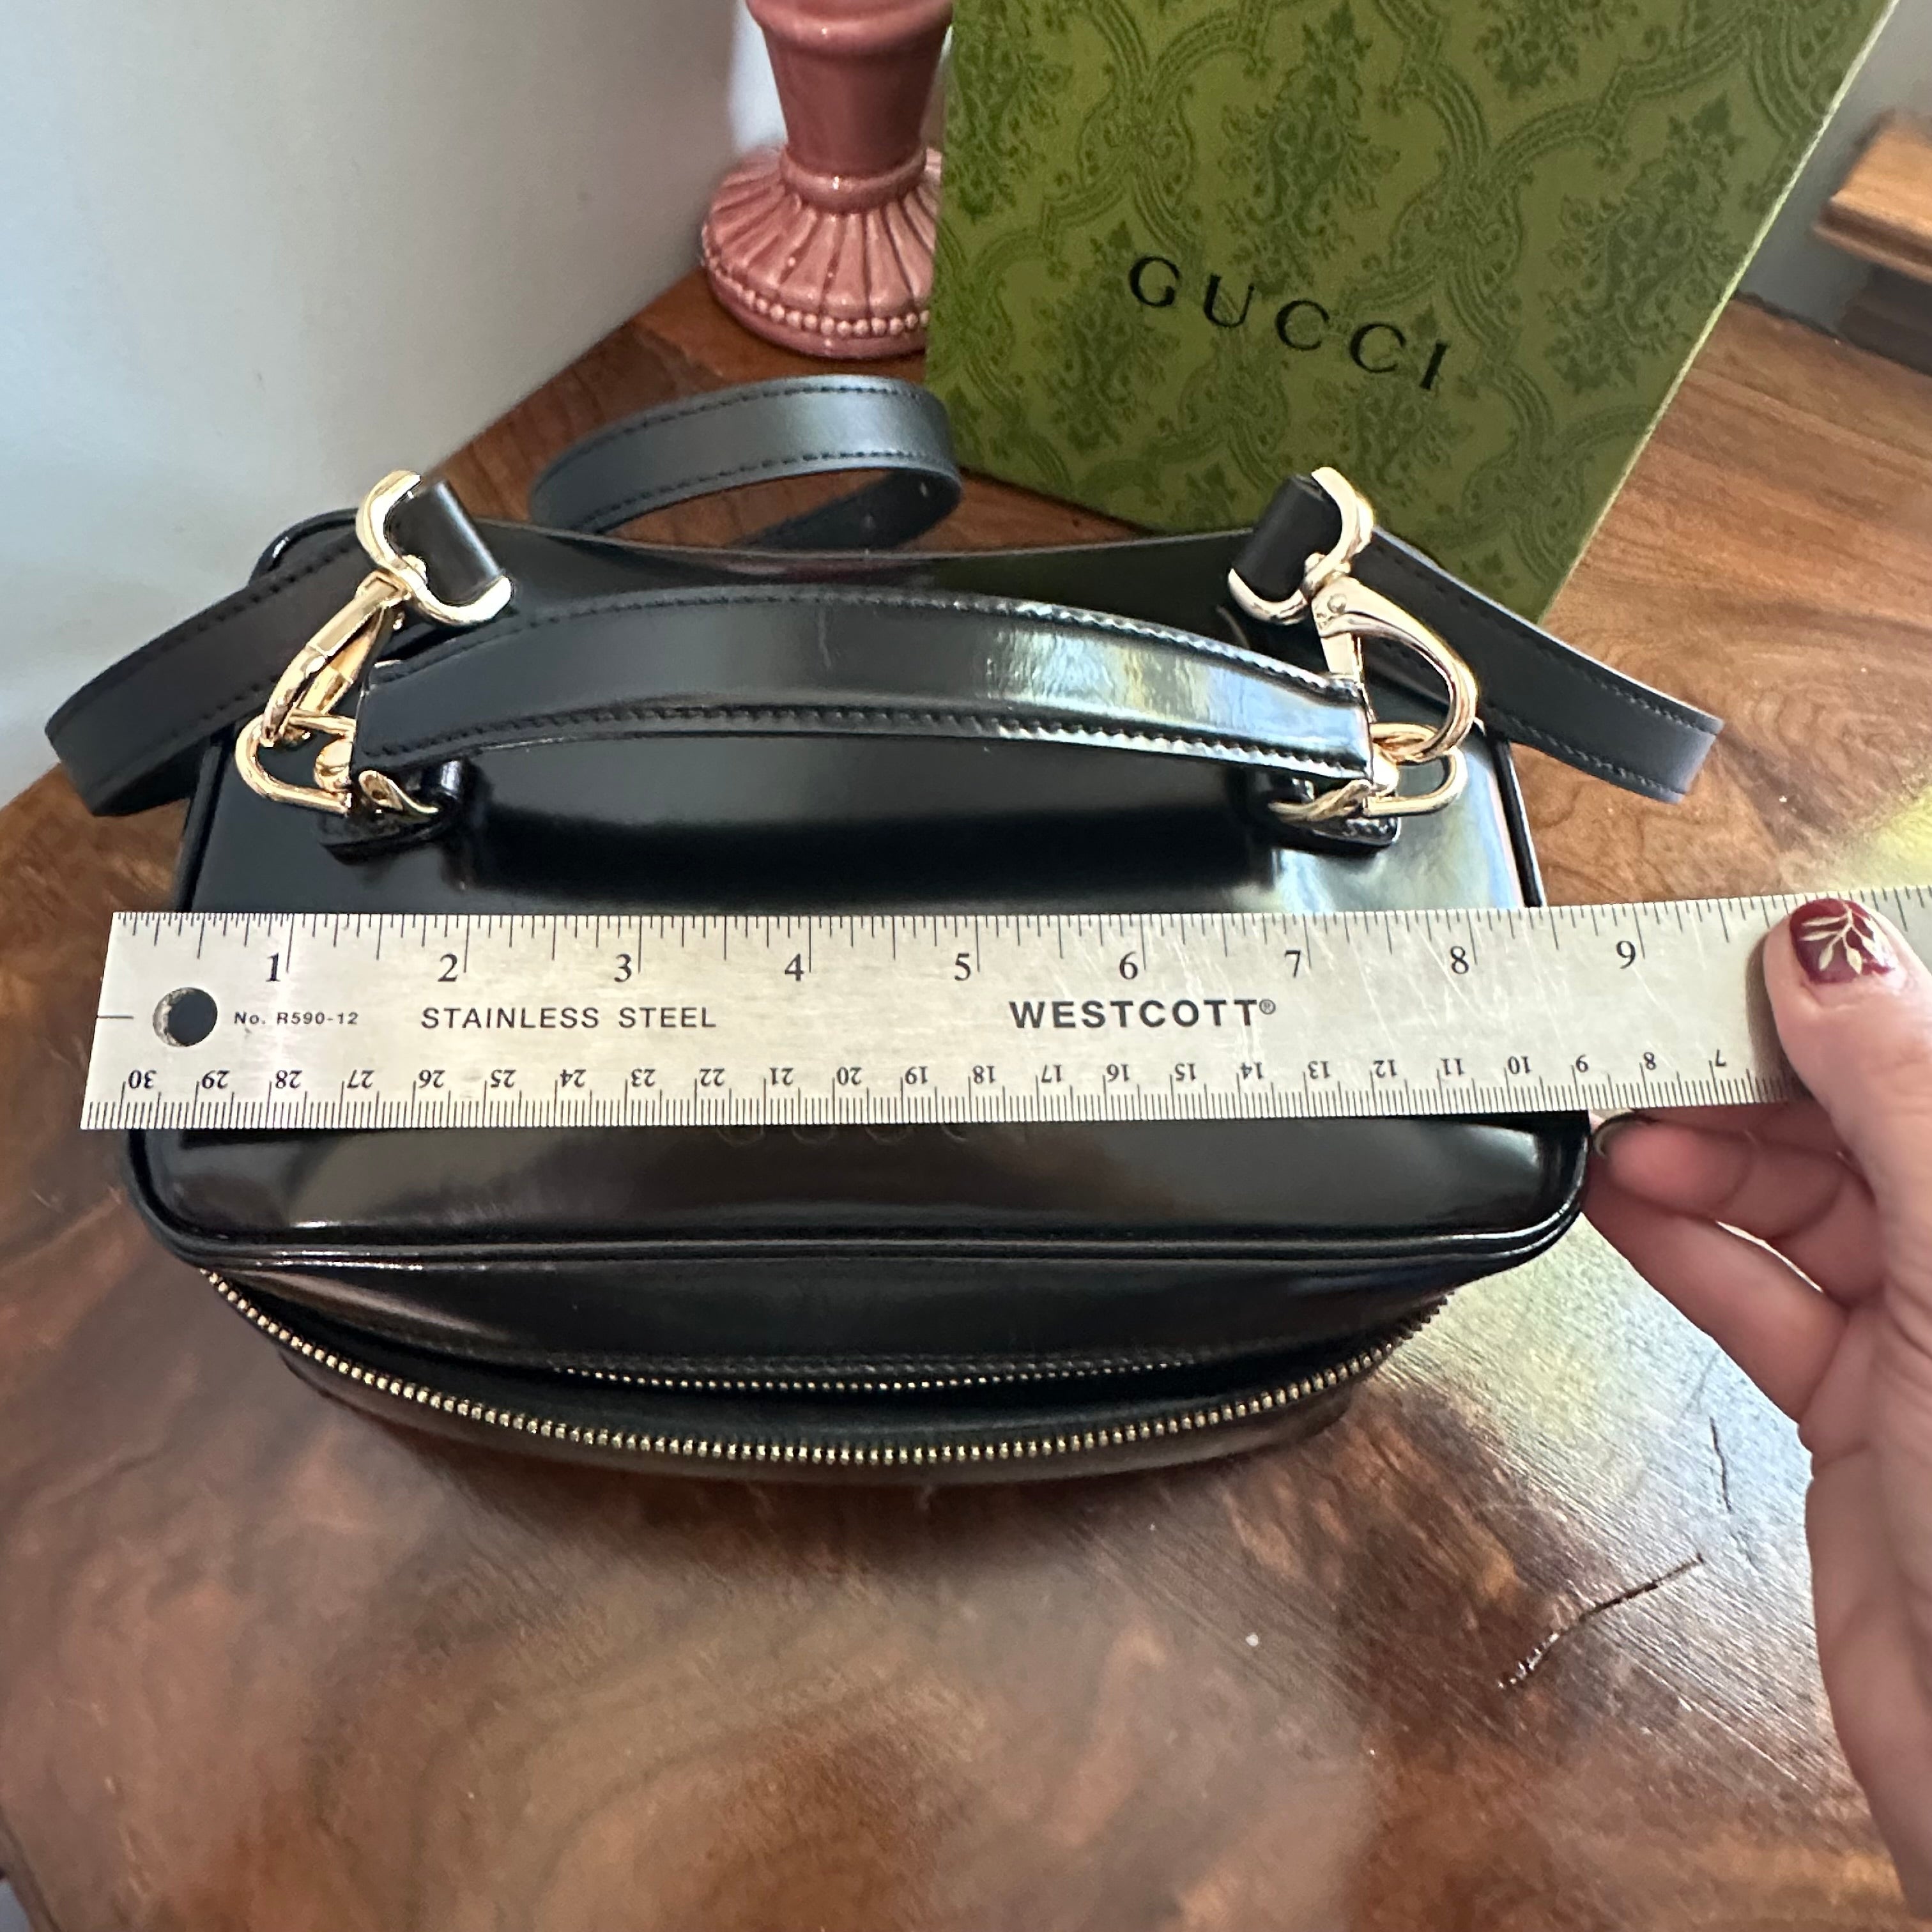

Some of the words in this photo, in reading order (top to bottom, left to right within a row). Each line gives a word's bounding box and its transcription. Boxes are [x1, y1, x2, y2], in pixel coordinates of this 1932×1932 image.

[1128, 256, 1449, 390] GUCCI
[265, 952, 280, 983] 1
[437, 953, 459, 983] 2
[613, 953, 632, 983] 3
[784, 953, 805, 982] 4
[954, 952, 972, 981] 5
[1118, 951, 1138, 980] 6
[1284, 949, 1302, 978] 7
[1449, 946, 1469, 975] 8
[1615, 940, 1636, 970] 9
[233, 1011, 266, 1025] No.
[276, 1011, 359, 1025] R590-12
[420, 1007, 599, 1030] STAINLESS
[618, 1006, 717, 1029] STEEL
[1372, 1059, 1398, 1078] 12
[1441, 1057, 1464, 1077] 11
[1506, 1055, 1531, 1075] 10
[1575, 1054, 1590, 1073] 9
[1643, 1052, 1657, 1071] 8
[1715, 1049, 1728, 1068] 7
[128, 1070, 157, 1090] 30
[201, 1070, 231, 1090] 29
[275, 1070, 303, 1090] 28
[346, 1069, 375, 1090] 27
[418, 1070, 446, 1089] 26
[490, 1069, 517, 1089] 25
[560, 1068, 586, 1089] 24
[630, 1068, 656, 1087] 23
[699, 1068, 726, 1087] 22
[769, 1067, 794, 1087] 21
[836, 1066, 862, 1086] 20
[904, 1066, 928, 1085] 19
[972, 1064, 996, 1085] 18
[1040, 1064, 1062, 1084] 17
[1106, 1063, 1130, 1083] 16
[1174, 1062, 1197, 1082] 15
[1239, 1062, 1264, 1080] 14
[1307, 1061, 1331, 1080] 13
